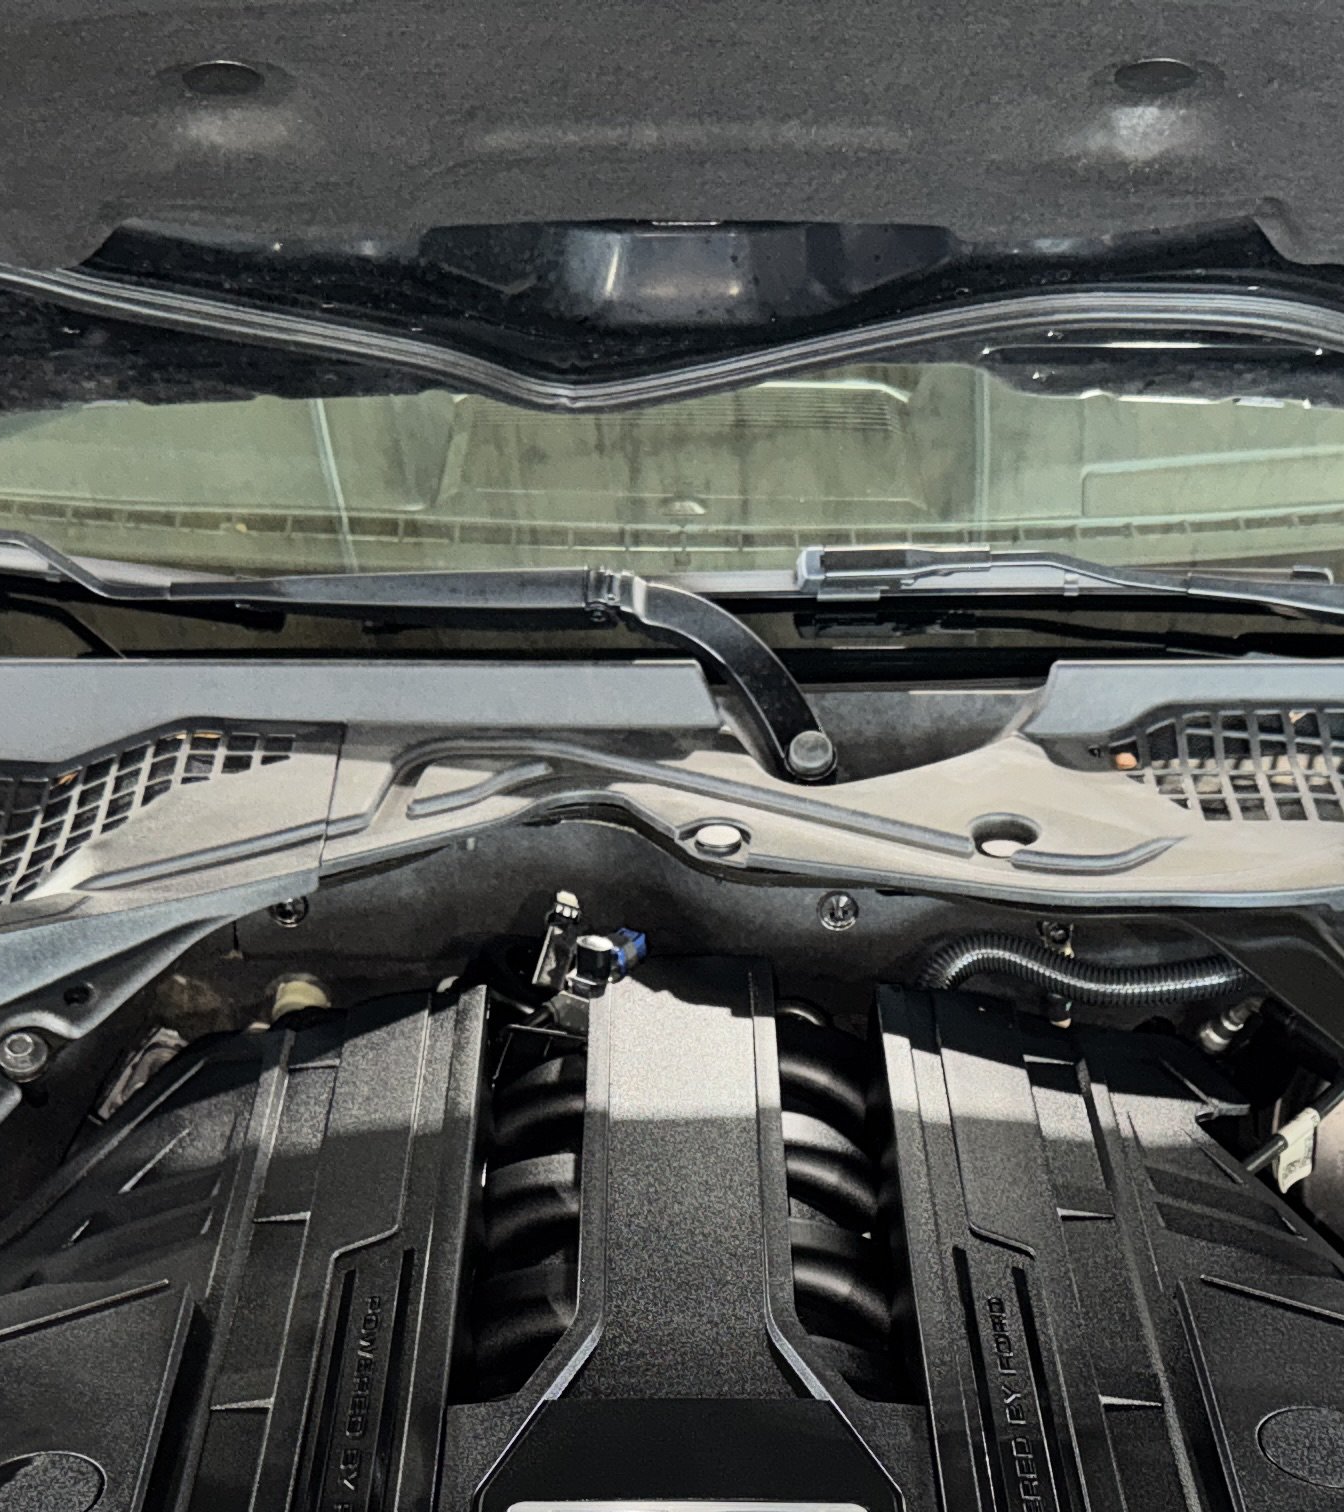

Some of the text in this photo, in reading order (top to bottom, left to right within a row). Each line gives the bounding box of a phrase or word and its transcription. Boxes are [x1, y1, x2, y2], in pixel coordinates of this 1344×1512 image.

[987, 1296, 1017, 1375] FORD
[346, 1296, 381, 1436] POWERED
[1002, 1385, 1027, 1426] BY
[340, 1450, 361, 1490] BY
